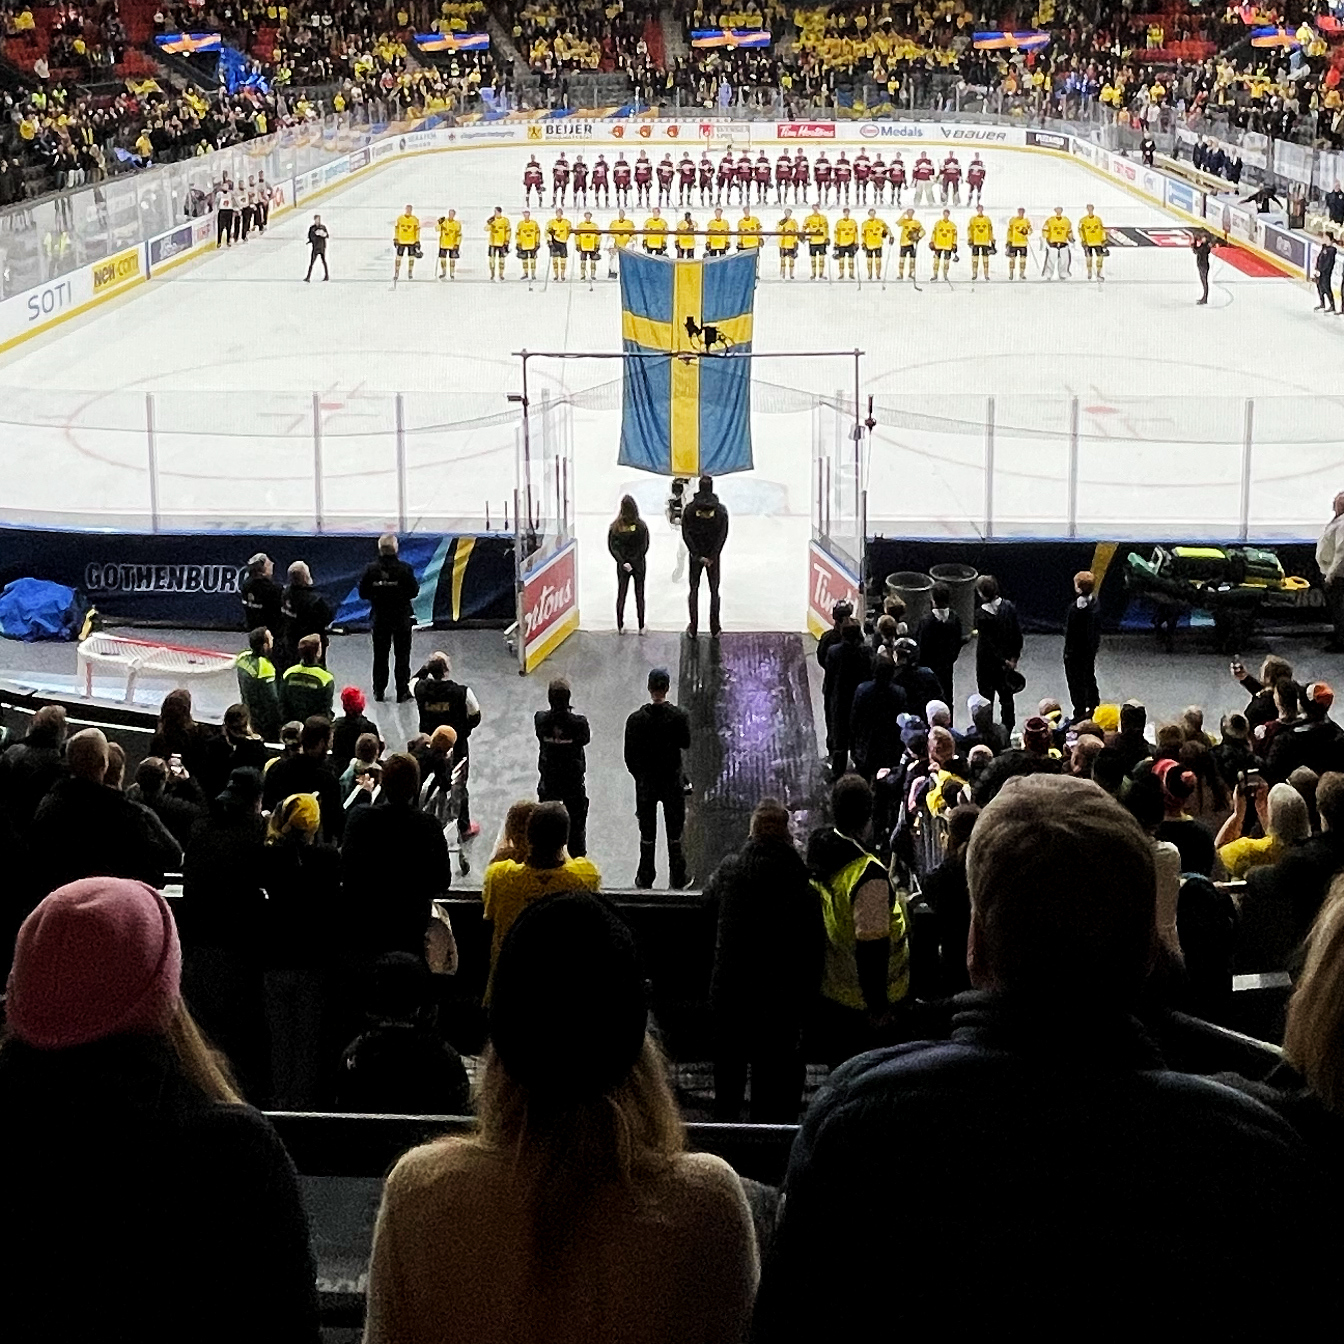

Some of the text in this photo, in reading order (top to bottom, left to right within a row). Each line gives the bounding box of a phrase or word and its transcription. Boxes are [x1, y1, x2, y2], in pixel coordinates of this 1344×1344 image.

[545, 124, 593, 134] BEIJER
[881, 125, 924, 138] Medals
[28, 280, 72, 321] SOTI
